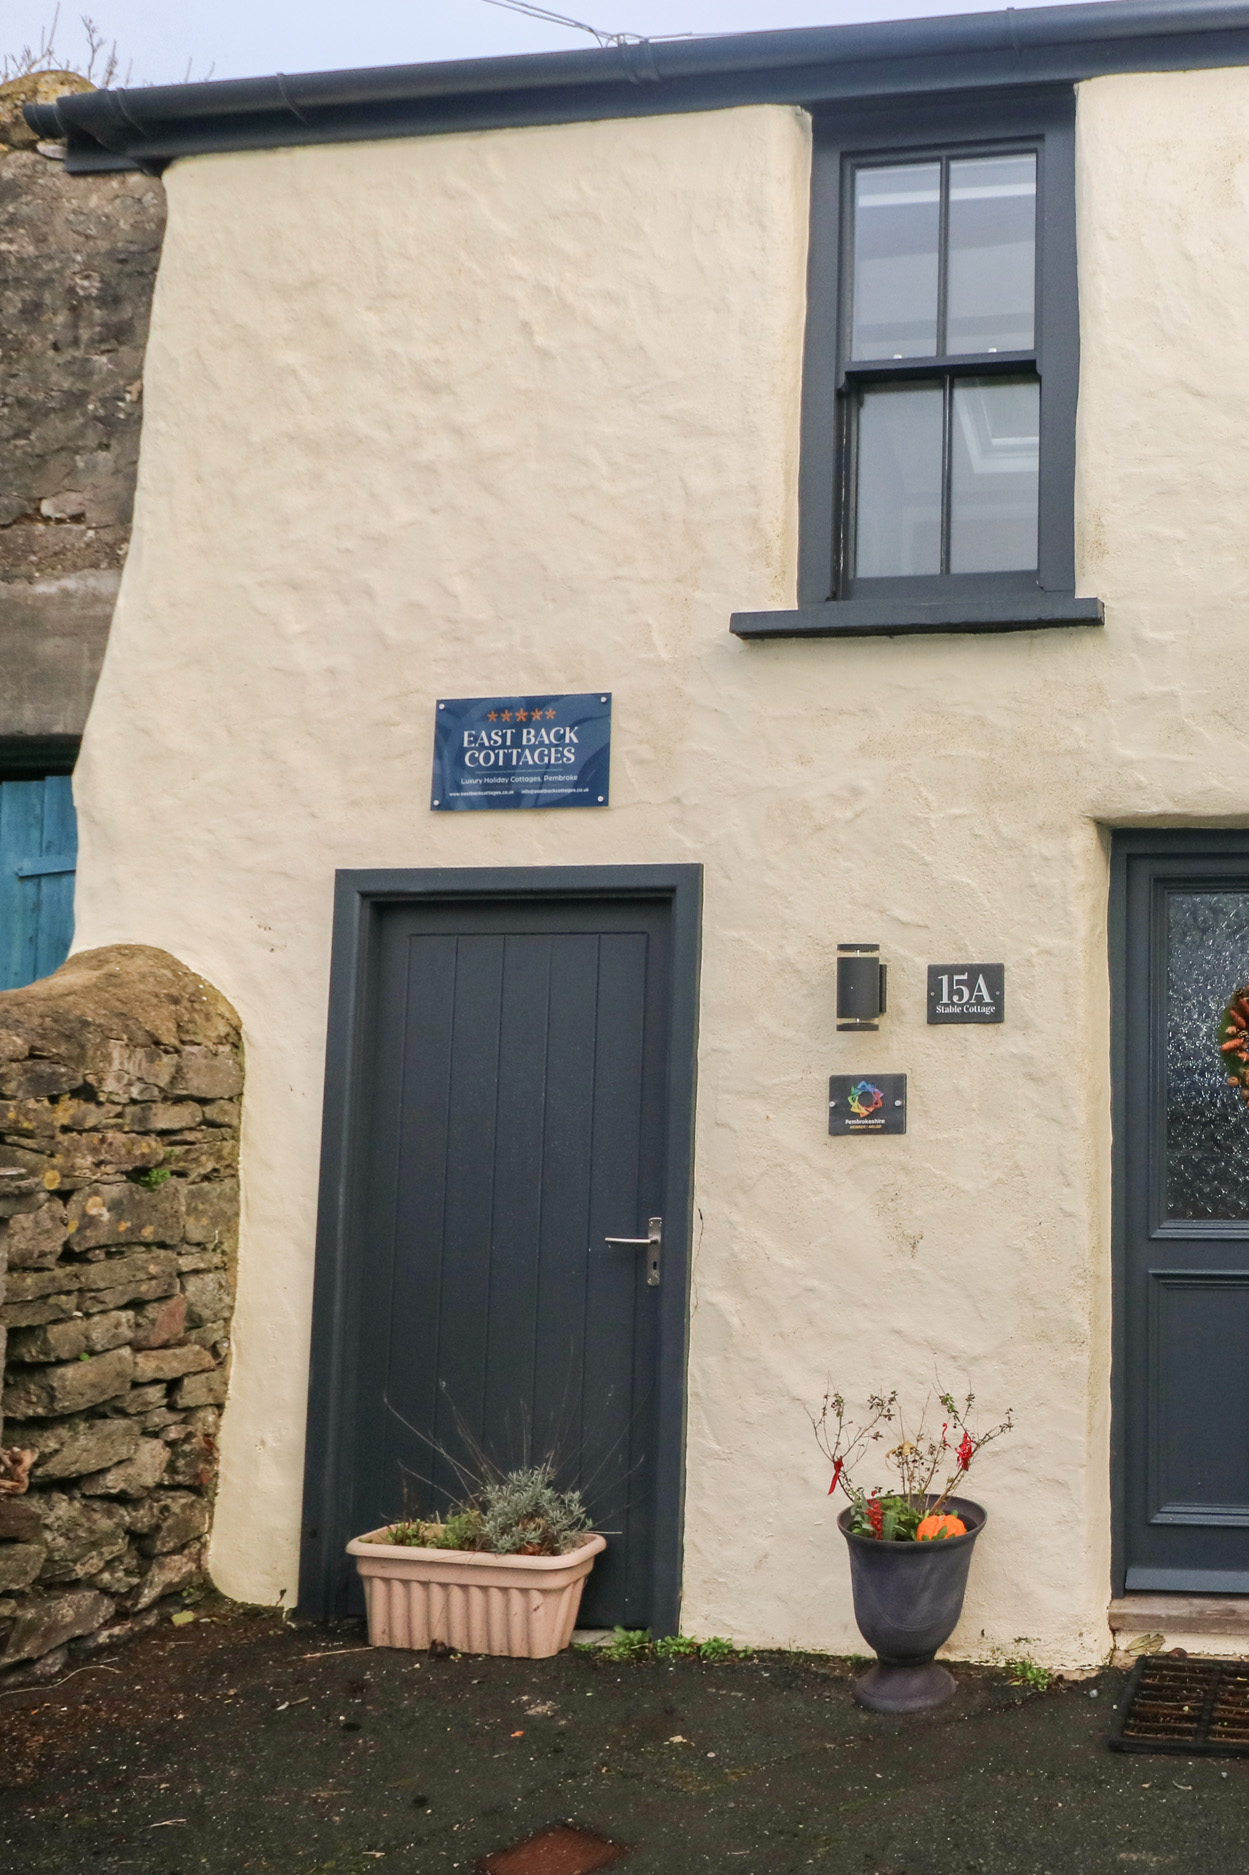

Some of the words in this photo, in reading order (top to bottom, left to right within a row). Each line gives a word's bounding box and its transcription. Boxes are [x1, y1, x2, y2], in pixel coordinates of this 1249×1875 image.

[463, 729, 515, 747] EAST
[522, 726, 579, 745] BACK
[464, 747, 575, 767] COTTAGES
[460, 777, 483, 785] Luxury
[484, 776, 509, 784] Holiday
[543, 774, 578, 782] Pembroke
[937, 971, 994, 1004] 15A
[936, 1004, 962, 1013] Stable
[963, 1004, 996, 1015] Cottage
